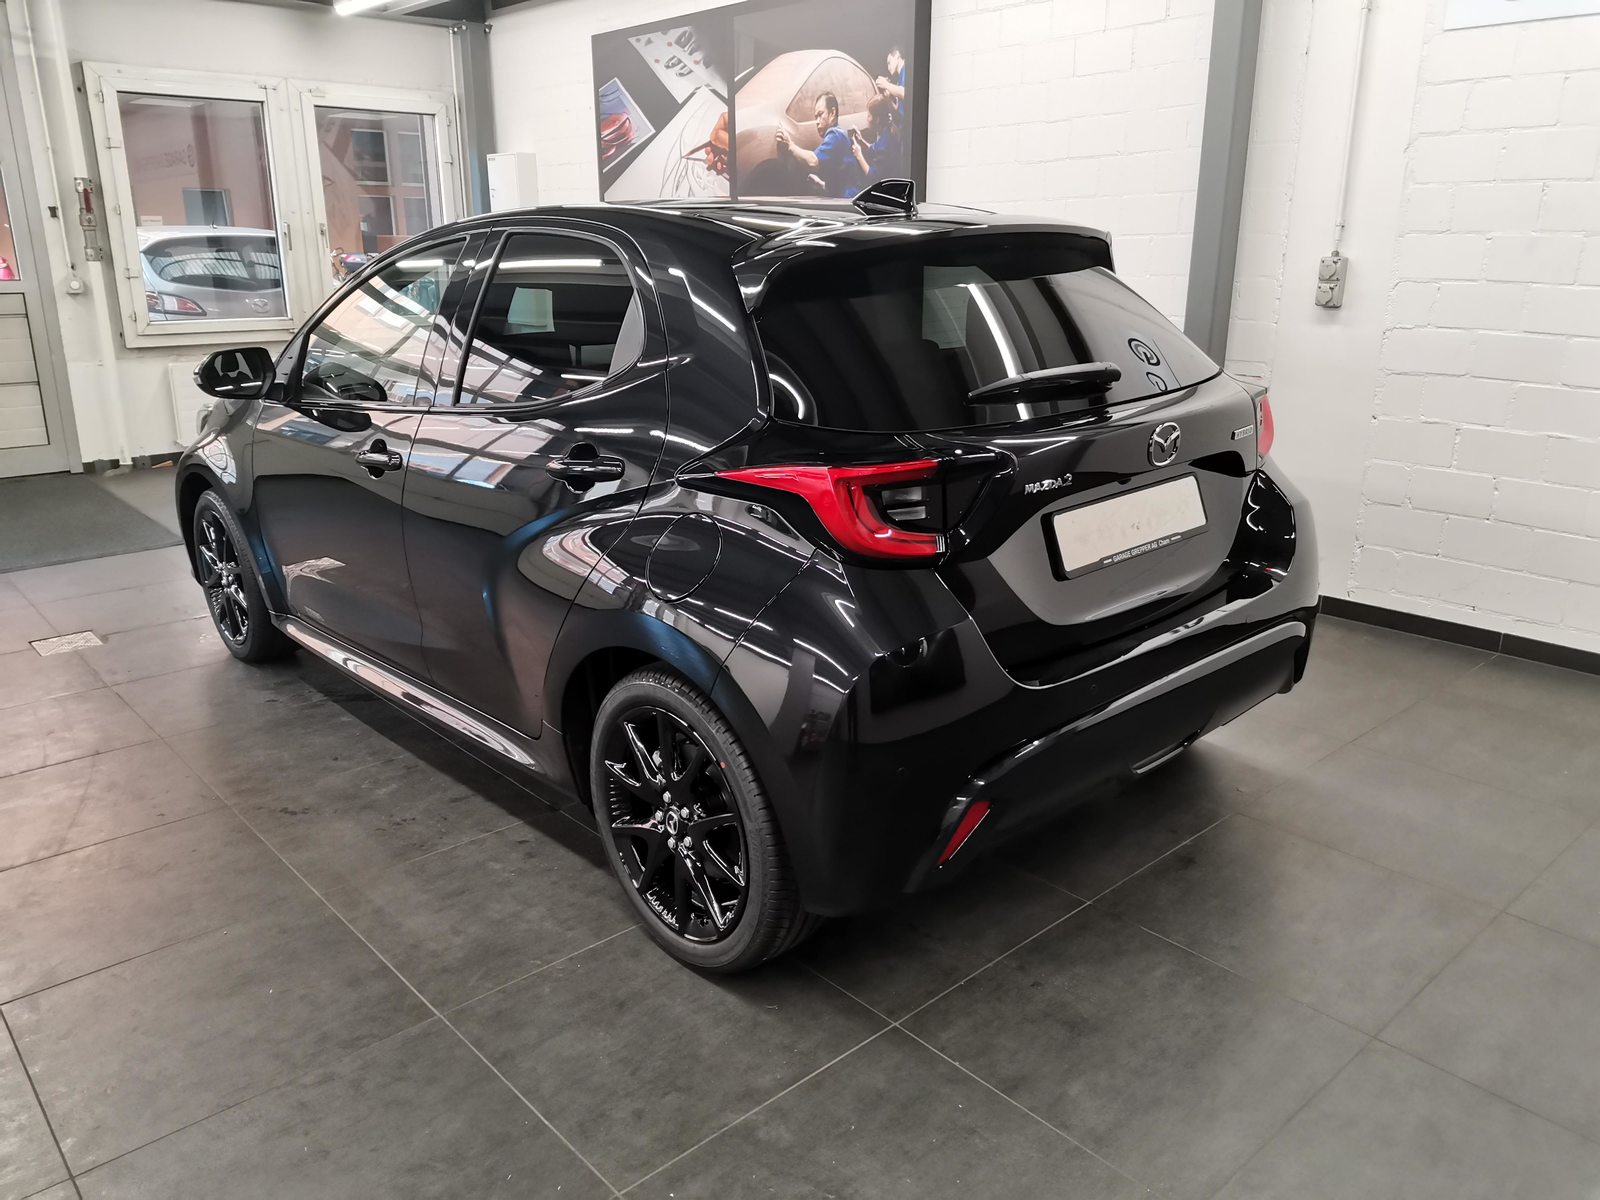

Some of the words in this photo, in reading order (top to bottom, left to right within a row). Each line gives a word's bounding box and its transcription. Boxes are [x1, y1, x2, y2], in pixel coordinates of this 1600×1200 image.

[1112, 551, 1131, 562] GARAGE
[1130, 544, 1151, 556] GREPPER
[1151, 541, 1158, 549] AG
